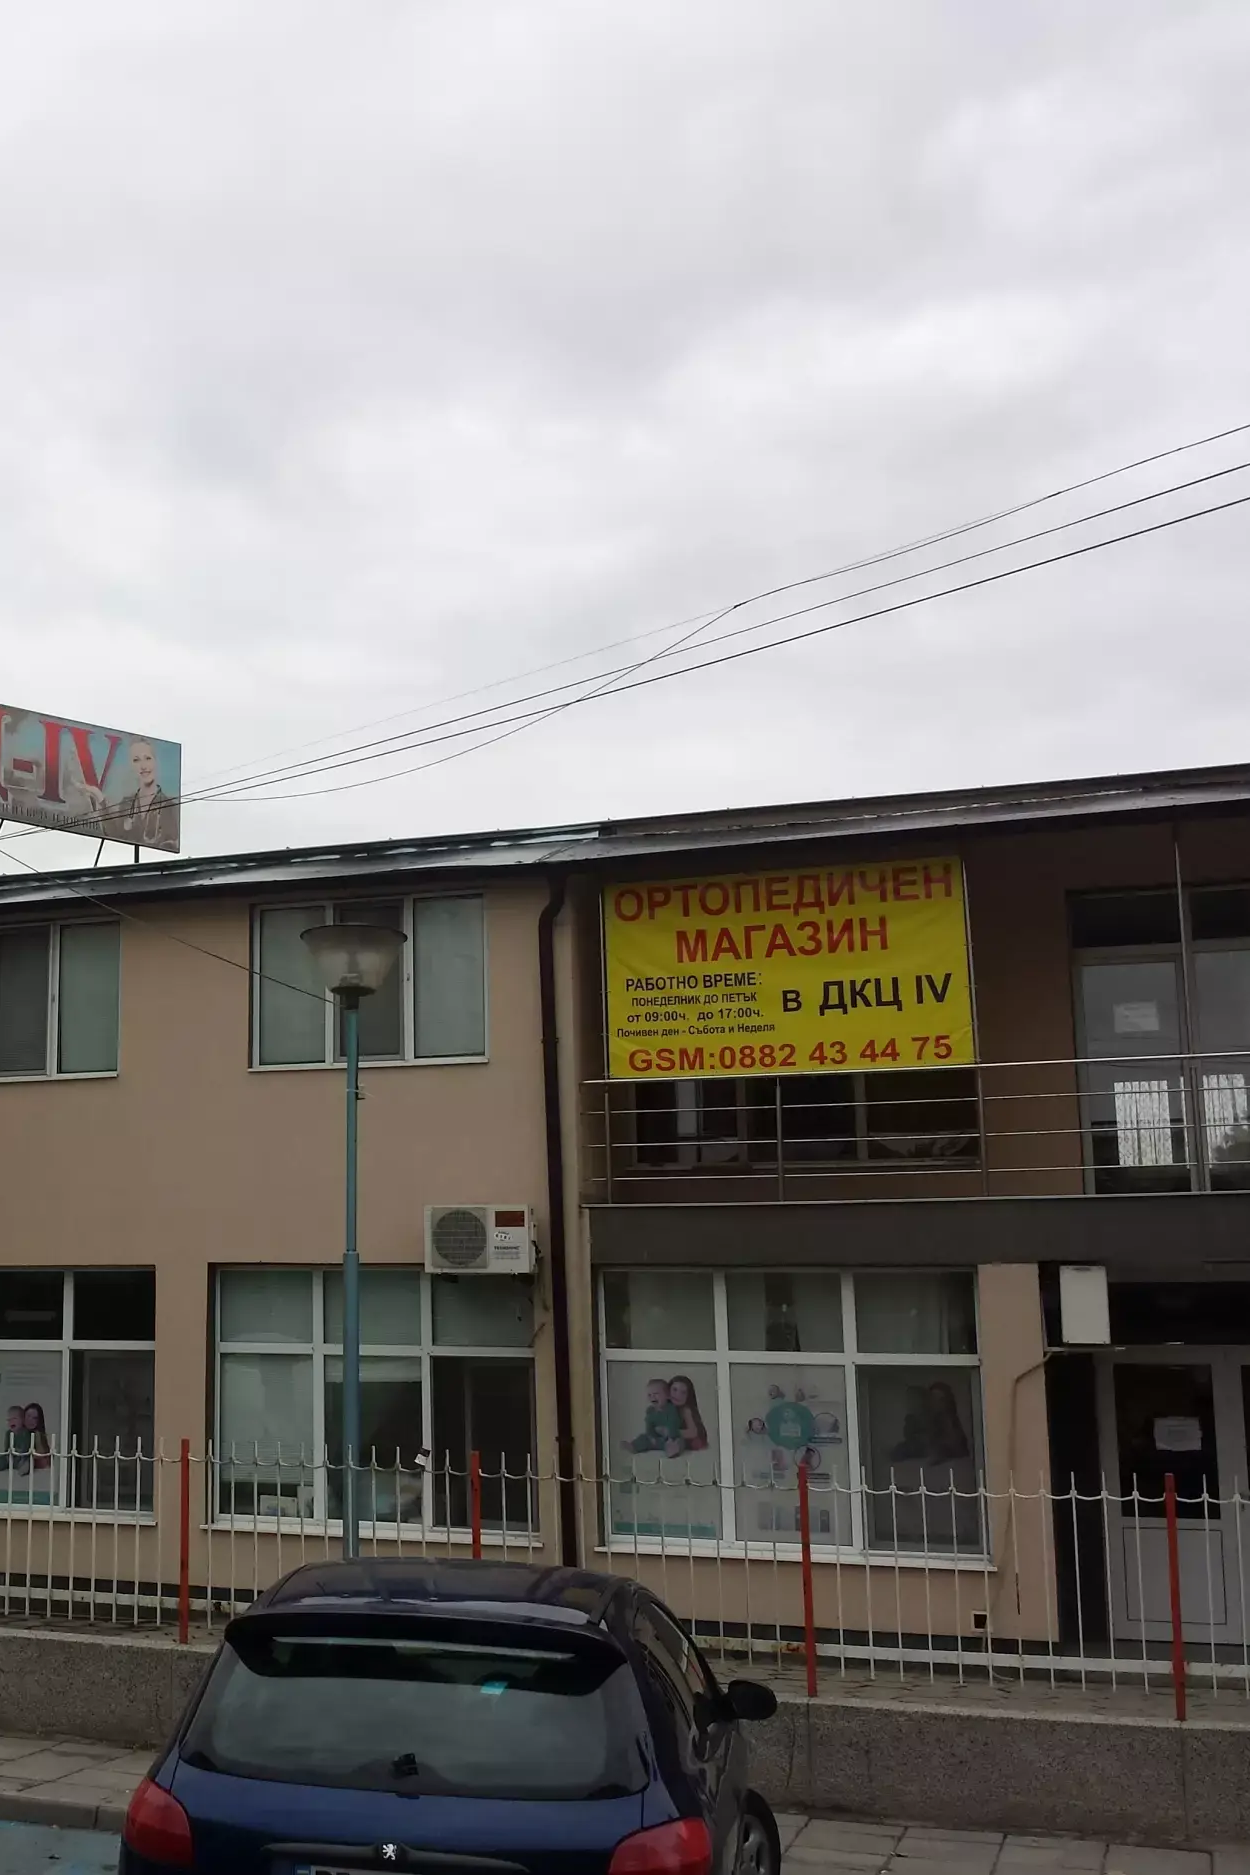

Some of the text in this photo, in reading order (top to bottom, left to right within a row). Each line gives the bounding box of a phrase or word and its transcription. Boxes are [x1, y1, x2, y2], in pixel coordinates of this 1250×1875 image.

[614, 863, 953, 922] ОРТОПЕДИЧЕН
[676, 916, 889, 963] МАГАЗИН
[625, 972, 762, 992] РАБОТНО ВРЕМЕ:
[819, 977, 903, 1016] ДКЦ
[915, 973, 952, 1004] IV
[632, 991, 757, 1007] ПОНЕДЕЛНИК ДО ПЕТЪК
[617, 1027, 659, 1037] Почивен
[661, 1026, 679, 1037] ден
[688, 1023, 725, 1035] Събота
[728, 1024, 735, 1033] и
[737, 1022, 775, 1033] Неделя
[627, 1013, 641, 1023] от
[697, 1009, 714, 1022] до
[718, 1007, 764, 1019] 17:00ч.
[628, 1034, 953, 1072] GSM:0882 43 44 75
